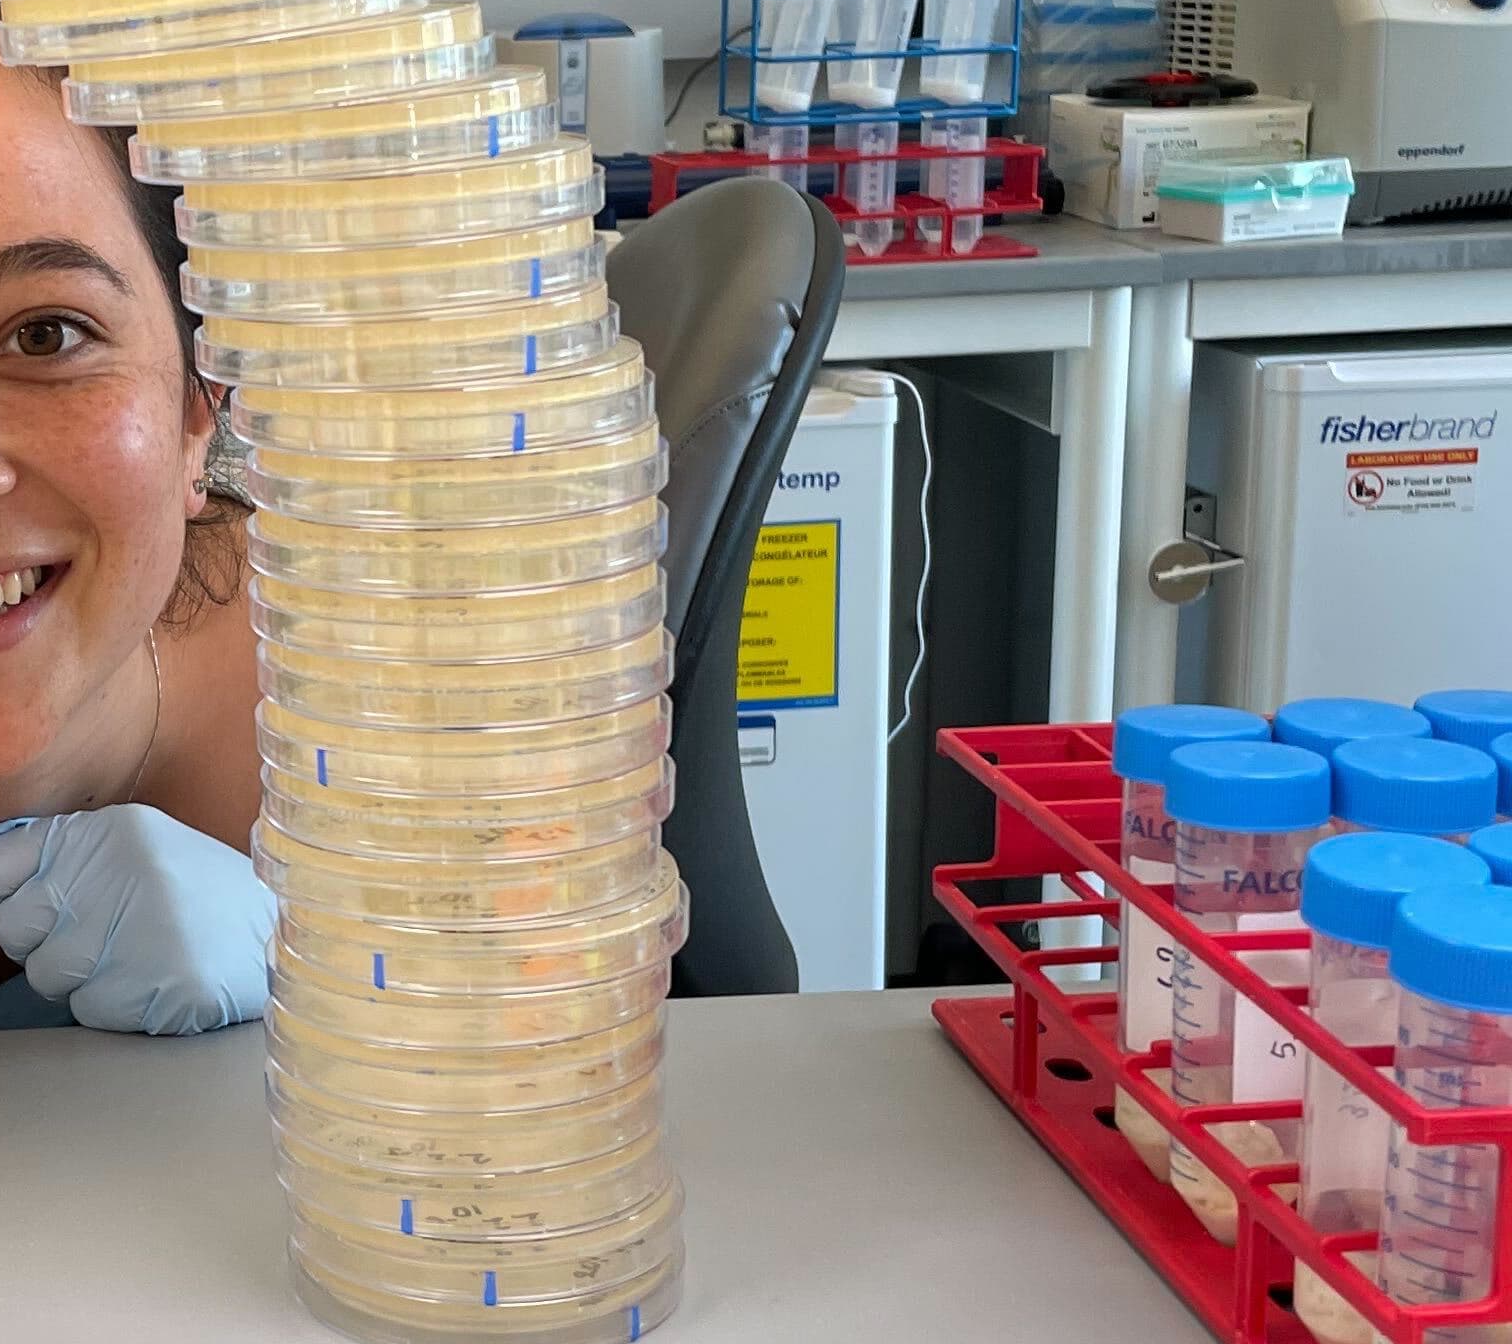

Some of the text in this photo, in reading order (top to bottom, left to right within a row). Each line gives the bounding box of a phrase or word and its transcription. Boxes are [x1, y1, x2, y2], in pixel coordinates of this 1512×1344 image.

[1397, 144, 1465, 162] eppendorf
[1320, 409, 1498, 445] fisherbrand
[1350, 451, 1474, 467] LABORATORY USE ONLY
[1403, 475, 1430, 486] Food
[1223, 868, 1304, 895] FALC
